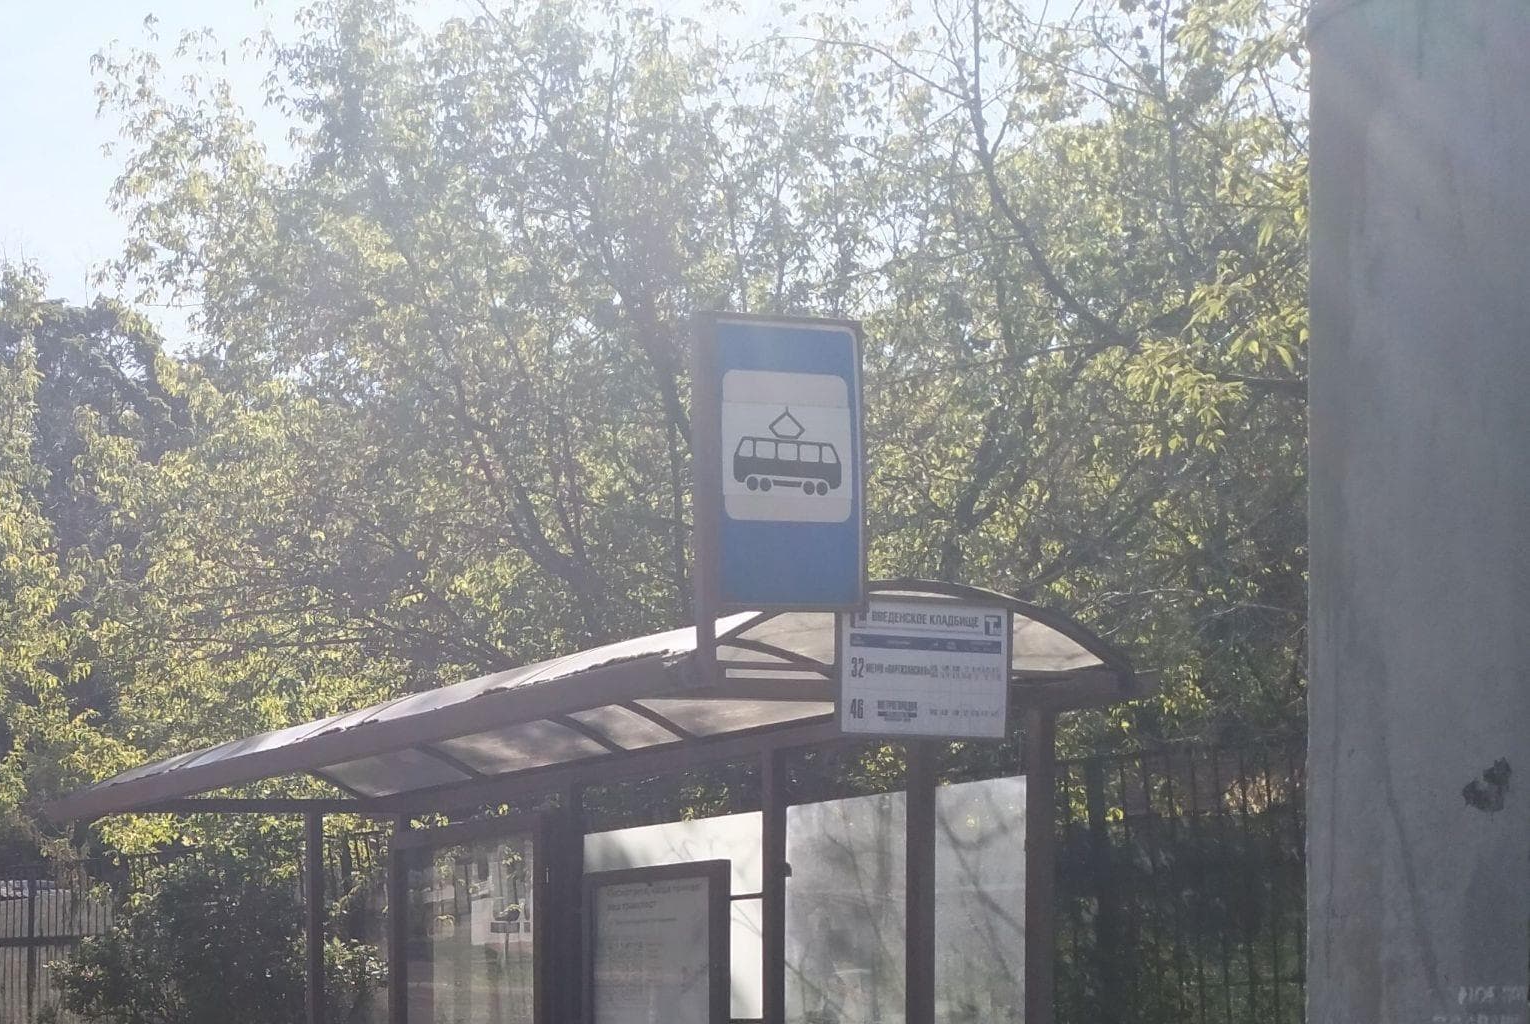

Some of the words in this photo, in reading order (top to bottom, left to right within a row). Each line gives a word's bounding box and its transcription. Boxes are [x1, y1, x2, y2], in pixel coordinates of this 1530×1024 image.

[872, 611, 927, 625] ВВЕДЕНСКОЕ
[929, 614, 979, 629] КЛАДБИЩЕ
[851, 657, 865, 678] 32
[850, 698, 864, 719] 46
